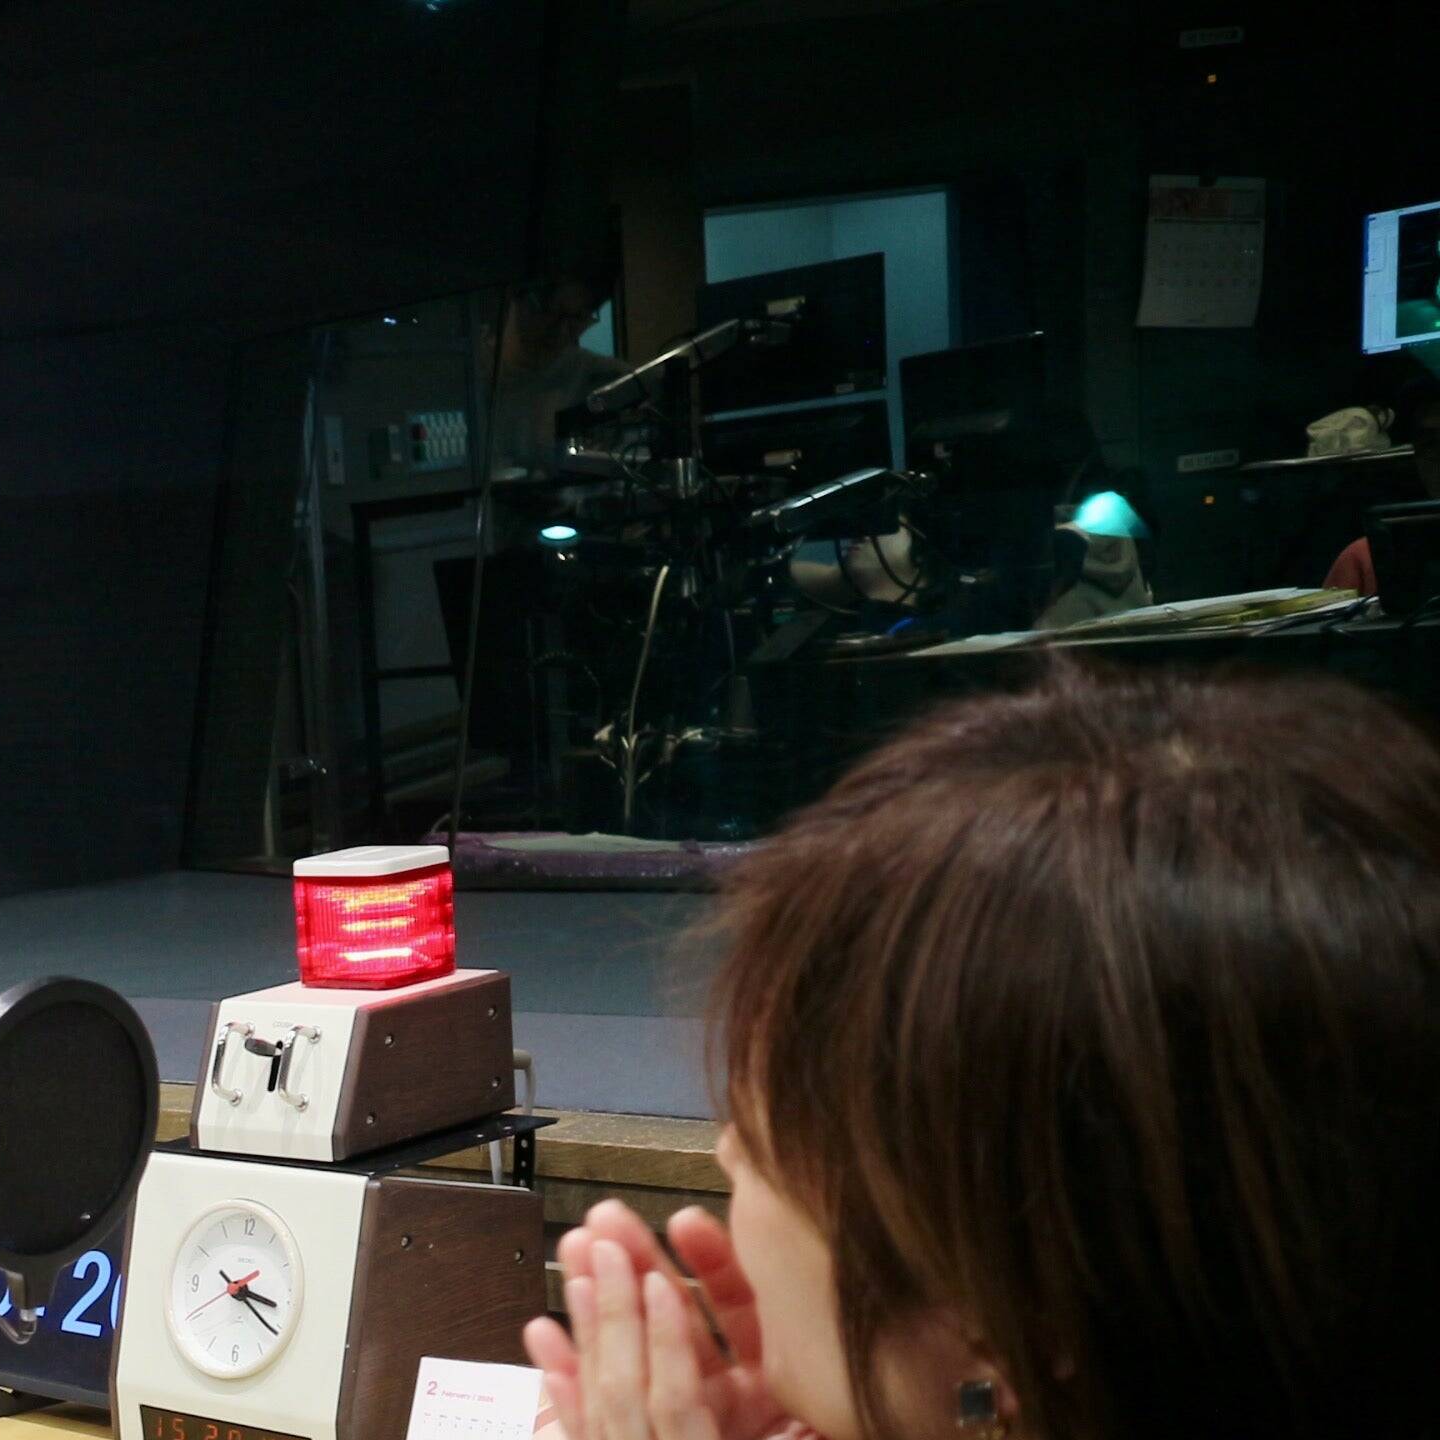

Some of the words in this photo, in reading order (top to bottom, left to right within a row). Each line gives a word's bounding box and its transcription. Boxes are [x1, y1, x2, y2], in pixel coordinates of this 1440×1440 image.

[244, 1218, 256, 1236] 12
[191, 1274, 200, 1292] 9
[231, 1344, 239, 1363] 6
[426, 1381, 438, 1396] 2
